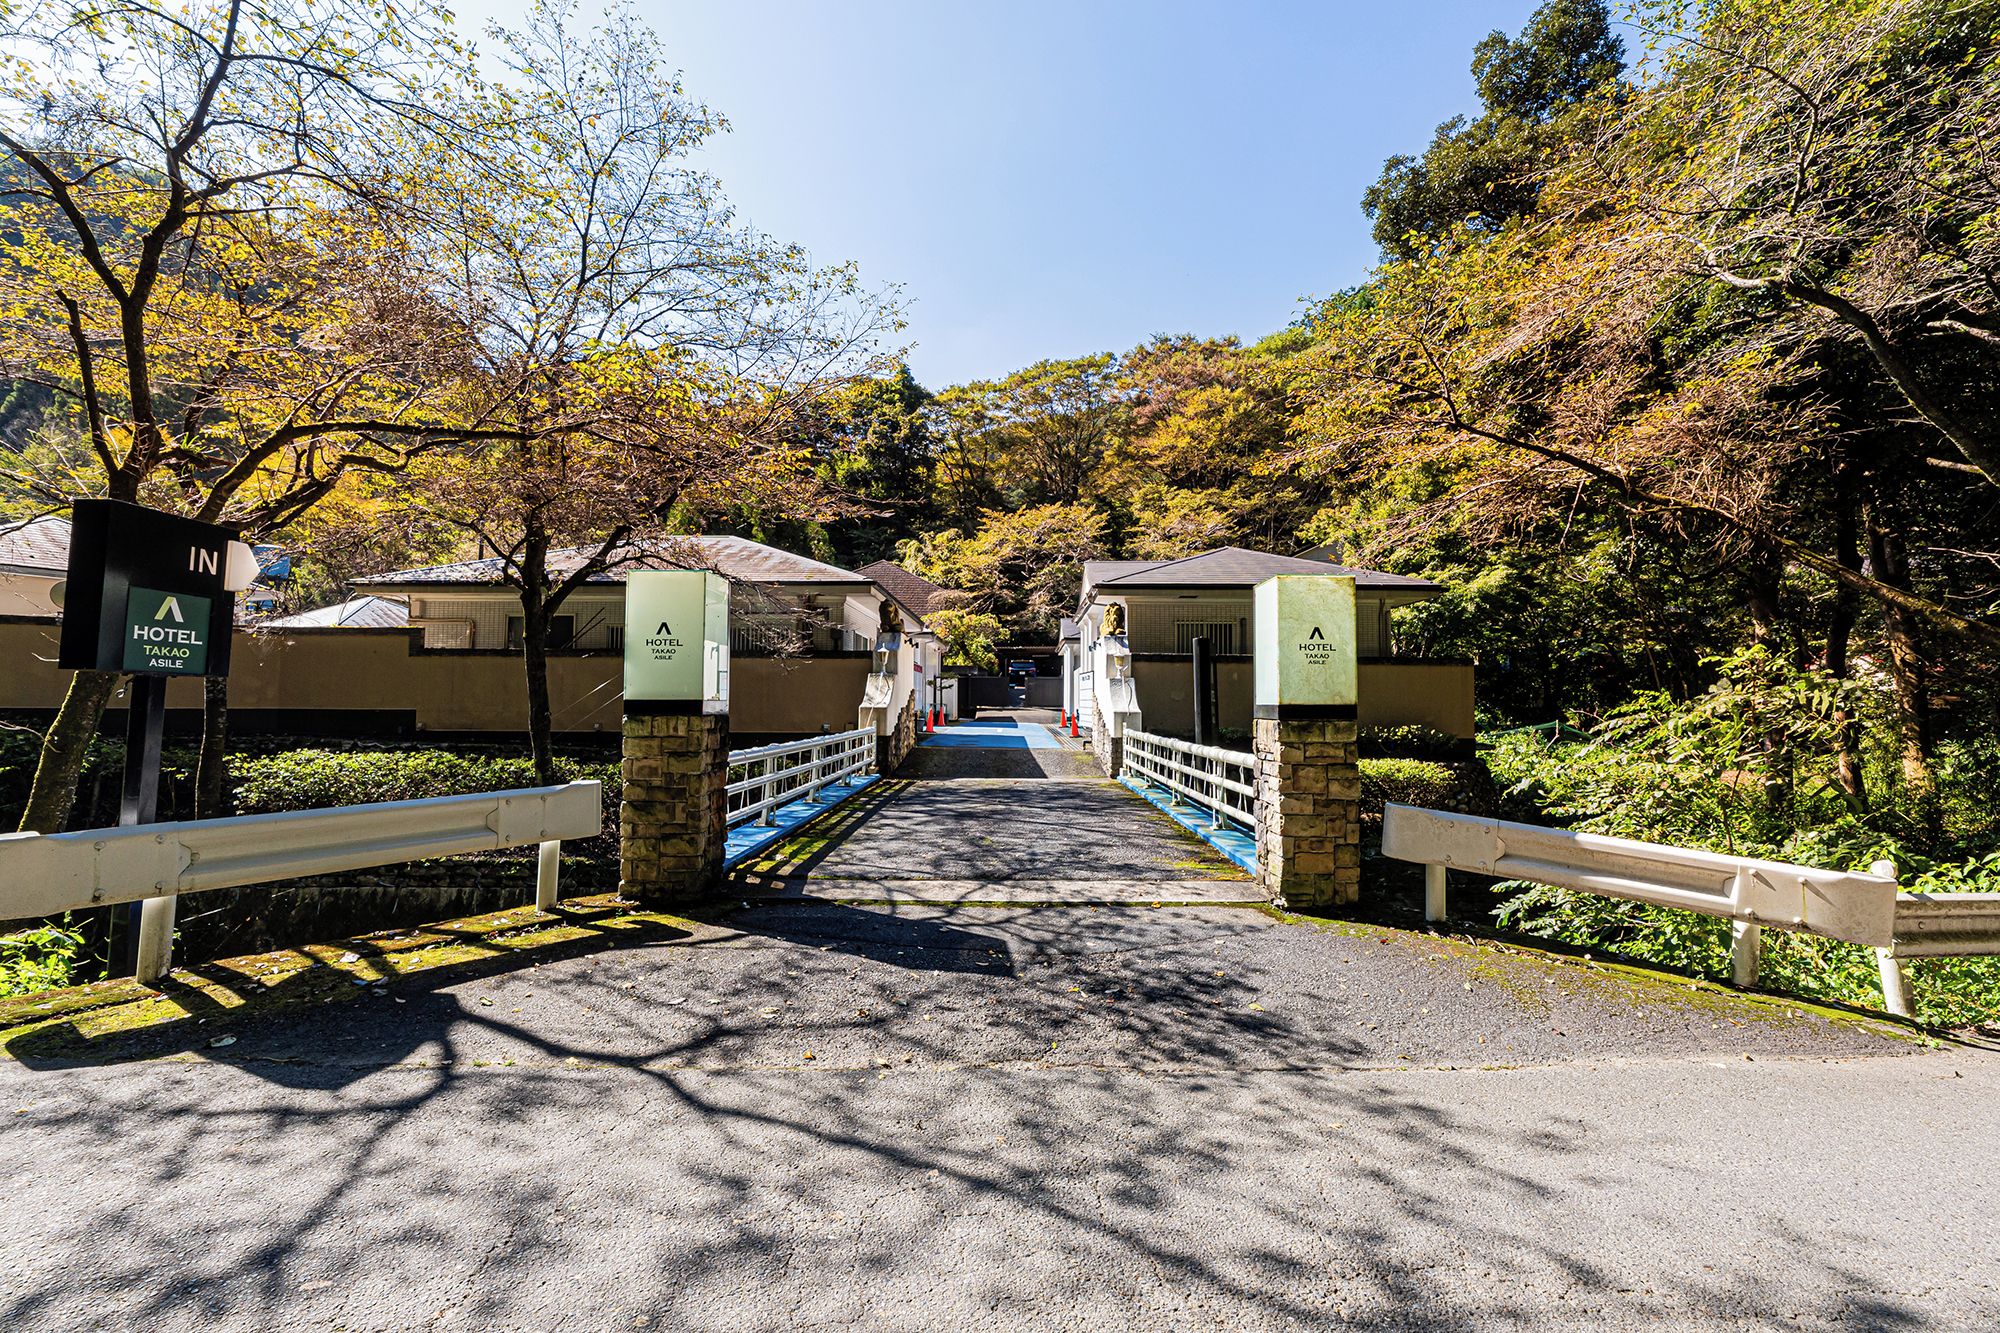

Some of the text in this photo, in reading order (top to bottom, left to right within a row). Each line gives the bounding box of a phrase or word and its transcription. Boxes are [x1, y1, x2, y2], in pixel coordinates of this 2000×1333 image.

[189, 546, 218, 576] IN
[133, 625, 203, 645] HOTEL
[645, 638, 683, 646] HOTEL
[1299, 643, 1337, 652] HOTEL
[143, 645, 190, 658] TAKAO
[149, 658, 184, 668] ASILE
